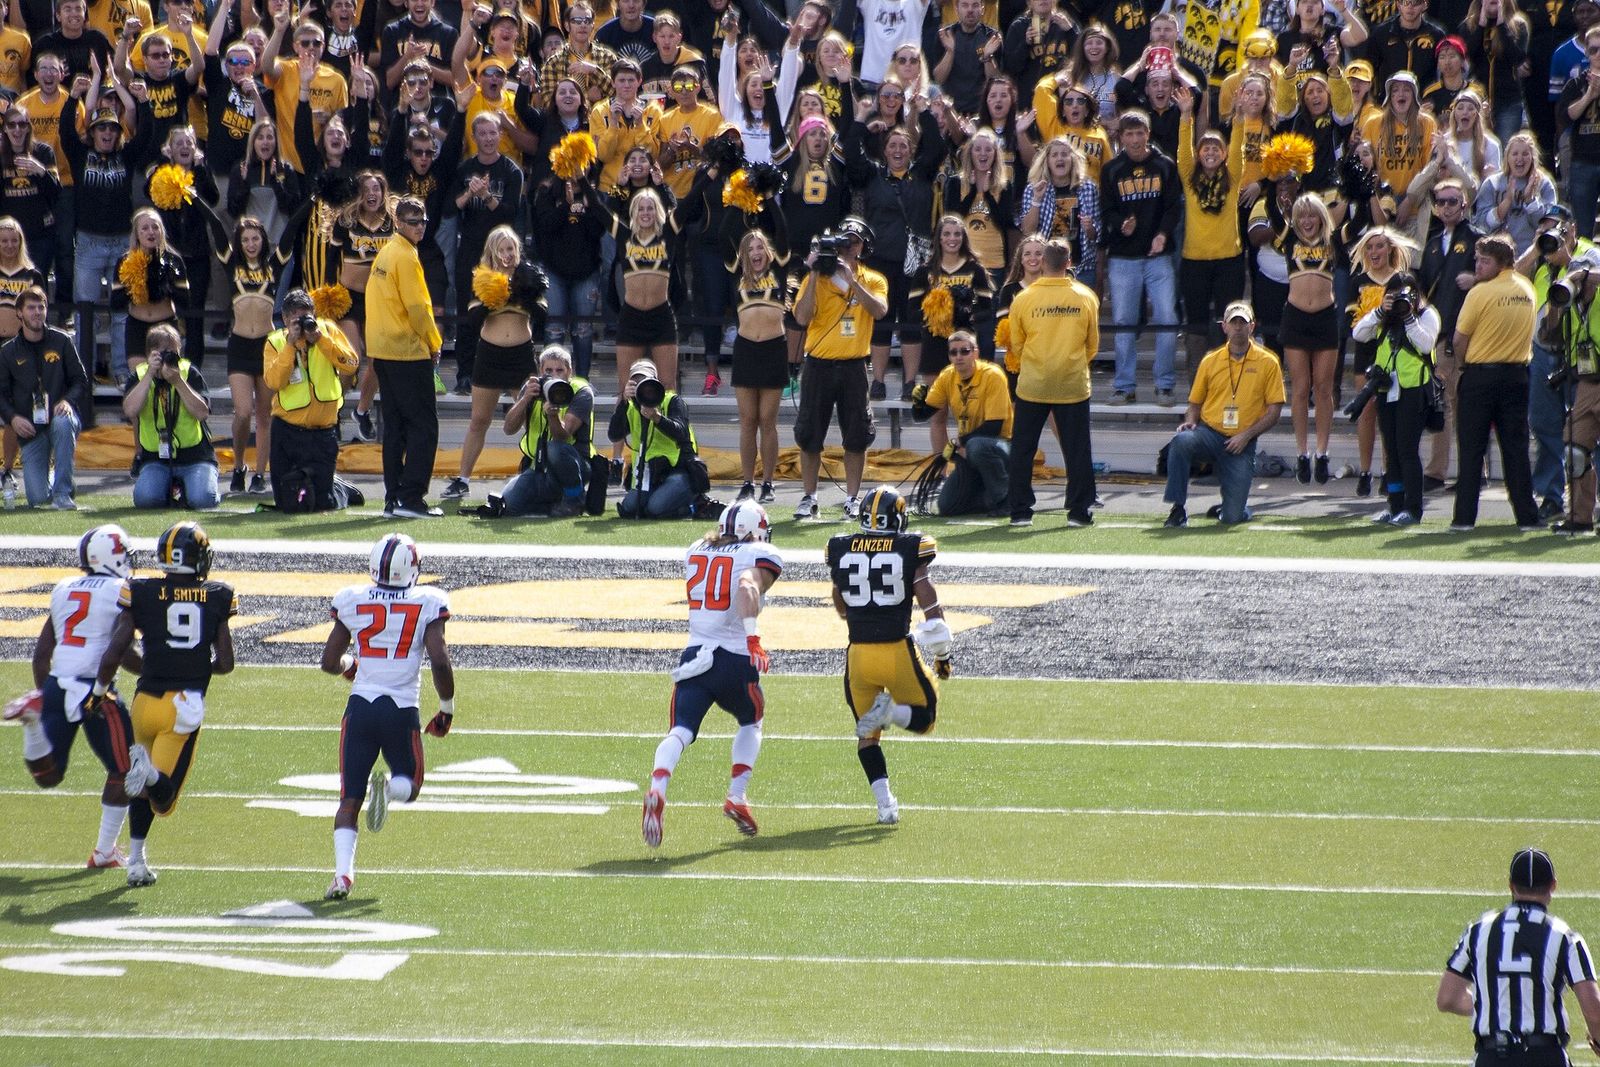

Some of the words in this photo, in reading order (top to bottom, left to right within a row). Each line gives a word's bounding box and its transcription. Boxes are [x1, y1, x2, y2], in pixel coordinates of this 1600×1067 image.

[1386, 159, 1414, 171] CITY
[803, 169, 828, 205] 6
[1117, 176, 1161, 196] IOWA
[625, 241, 668, 261] IOWA
[1046, 305, 1081, 314] whelan
[862, 512, 887, 529] 33
[851, 538, 894, 552] CANZERI
[171, 548, 183, 568] 9
[686, 554, 734, 612] 20
[839, 553, 906, 607] 33
[158, 587, 168, 601] J.
[173, 588, 208, 603] SMITH
[368, 589, 408, 600] SPENCE
[61, 591, 92, 648] 2
[165, 601, 201, 649] 9
[356, 603, 424, 660] 27
[1498, 922, 1533, 973] L
